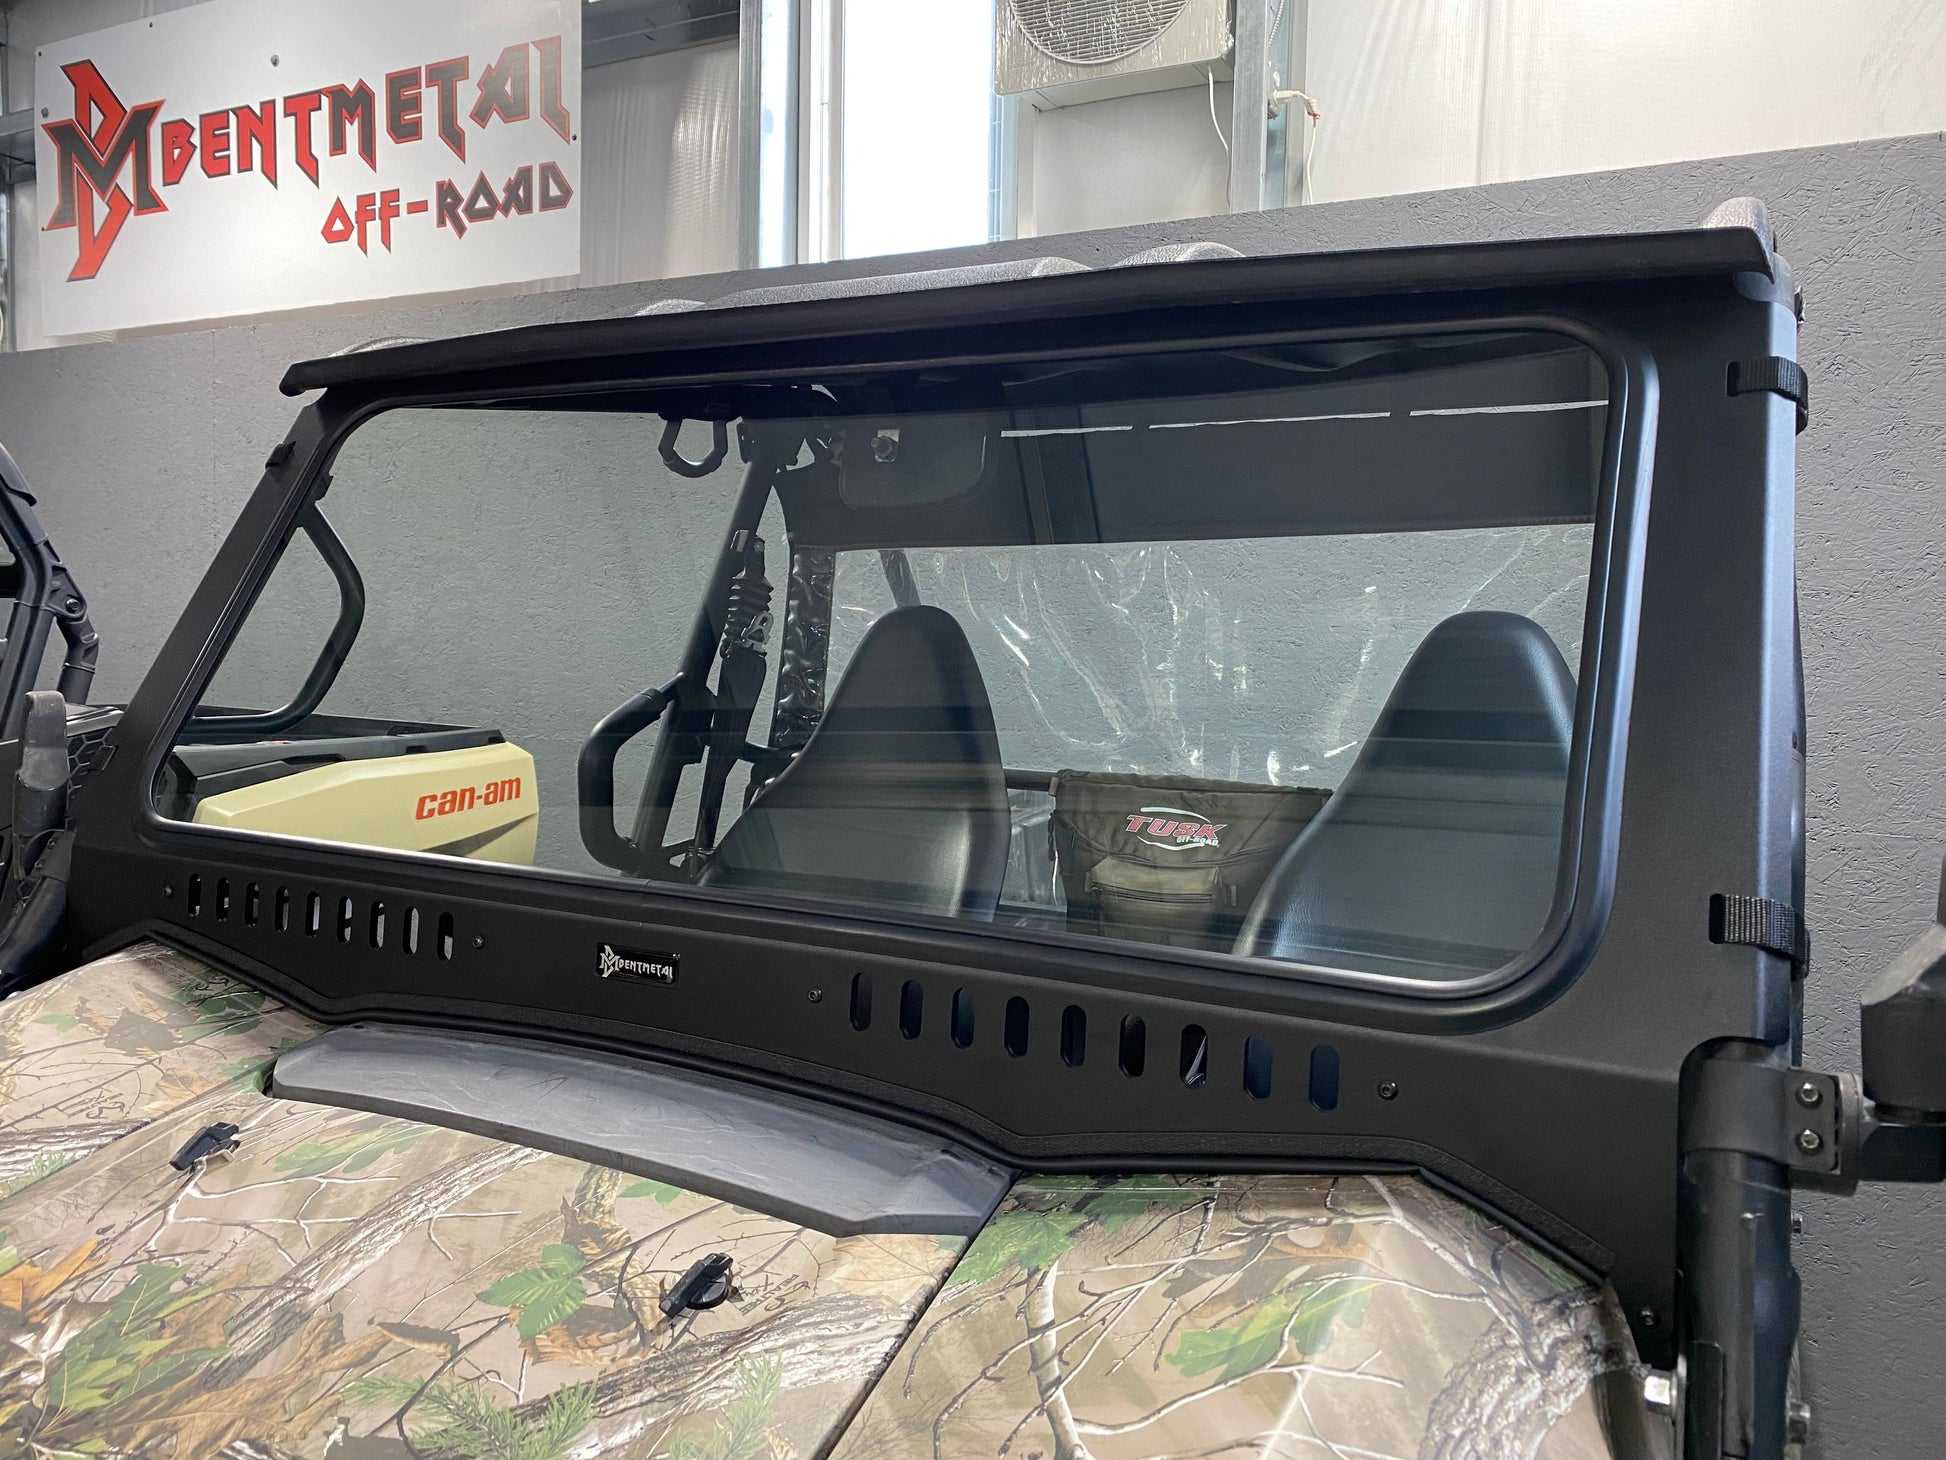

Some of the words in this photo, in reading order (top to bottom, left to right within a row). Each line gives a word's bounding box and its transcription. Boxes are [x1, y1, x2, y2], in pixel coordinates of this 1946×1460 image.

[161, 35, 571, 191] BENTMETAL
[320, 161, 574, 258] OFF-ROAD
[415, 777, 521, 821] can-am
[1126, 814, 1228, 840] TUSK
[1176, 835, 1219, 848] OFF-ROAD
[739, 1273, 800, 1317] REALTREE
